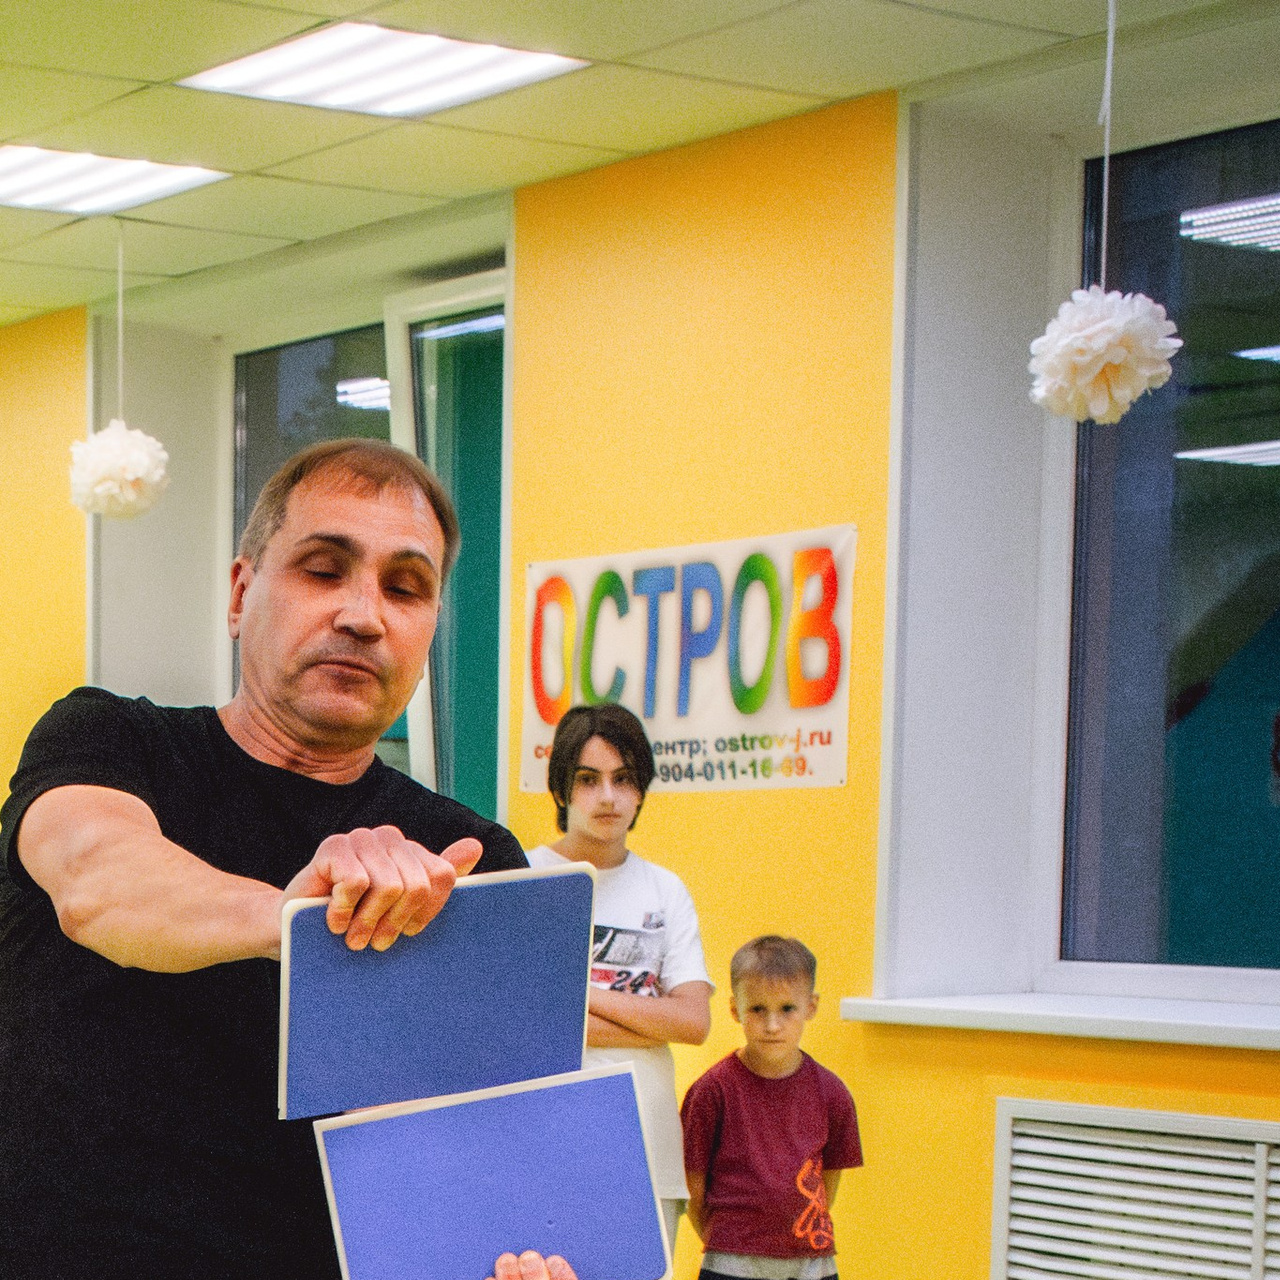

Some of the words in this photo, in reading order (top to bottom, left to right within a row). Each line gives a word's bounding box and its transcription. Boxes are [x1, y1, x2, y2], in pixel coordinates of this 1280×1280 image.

[531, 547, 841, 726] ОСТРОВ
[651, 737, 708, 758] ентр;
[714, 728, 833, 754] ostrov-j.ru
[654, 755, 814, 783] -904-011-16-69.
[610, 970, 650, 994] 24
